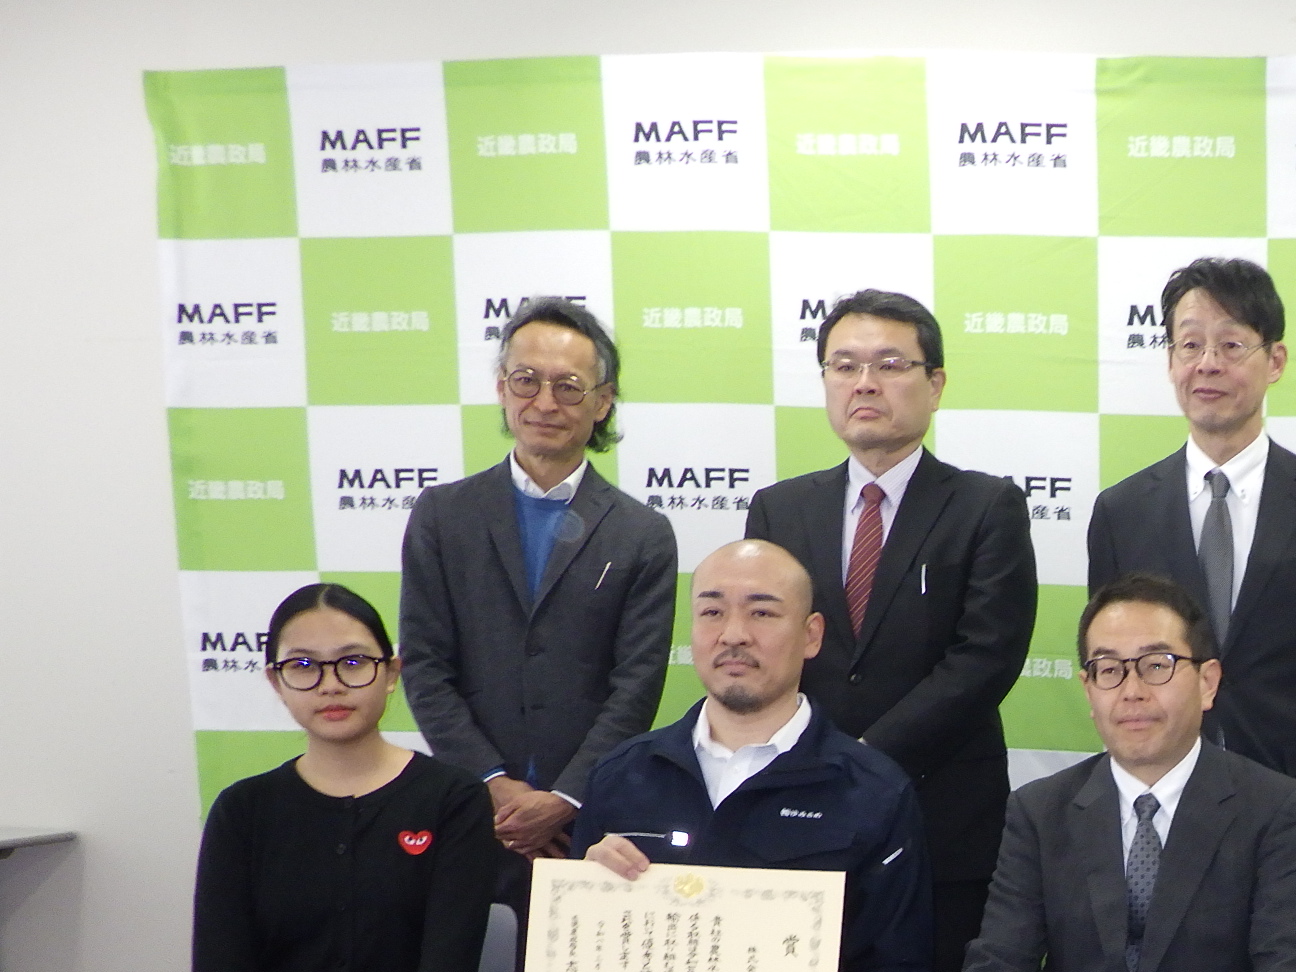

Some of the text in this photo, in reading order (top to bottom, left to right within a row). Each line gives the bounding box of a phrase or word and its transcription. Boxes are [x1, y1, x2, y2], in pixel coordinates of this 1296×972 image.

[321, 128, 420, 150] MAFF
[634, 120, 737, 142] MAFF
[959, 122, 1067, 144] MAFF
[170, 143, 266, 166] 近畿農政局
[478, 132, 578, 157] 近畿農政局
[796, 133, 900, 156] 近畿農政局
[1128, 135, 1235, 158] 近畿農政局
[322, 157, 421, 172] 農林水産省
[635, 150, 738, 165] 農林水産省
[959, 152, 1066, 168] 農林水産省
[177, 303, 276, 323] MAFF
[331, 311, 430, 332] 近畿農政局
[643, 307, 743, 328] 近畿農政局
[964, 312, 1068, 335] 近畿農政局
[179, 331, 277, 344] 農林水産省
[337, 468, 438, 489] MAFF
[646, 468, 749, 488] MAFF
[1024, 476, 1072, 499] FF
[189, 480, 285, 500] 近畿農政局
[338, 496, 416, 510] 農林水産
[646, 495, 750, 511] 農林水産省
[201, 631, 268, 652] MAF
[202, 659, 262, 672] 農林水
